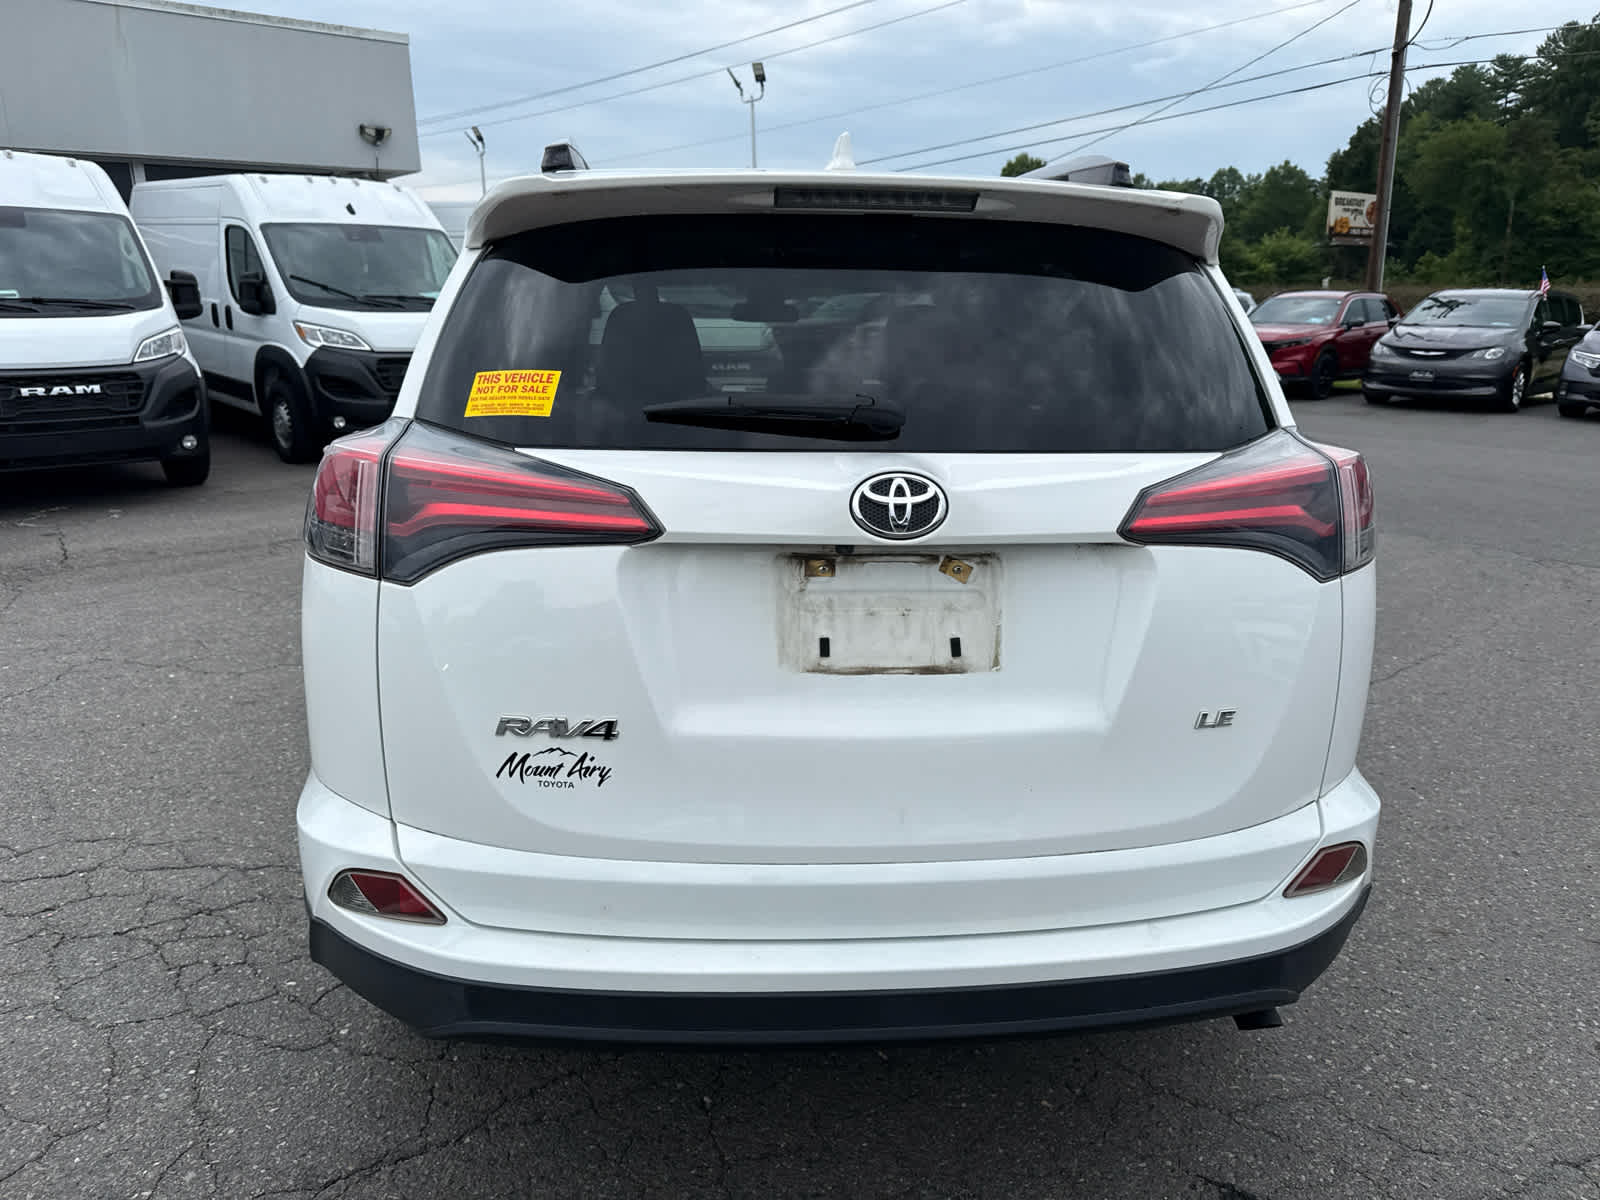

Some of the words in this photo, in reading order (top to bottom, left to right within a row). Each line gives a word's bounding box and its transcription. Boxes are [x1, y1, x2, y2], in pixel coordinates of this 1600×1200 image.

[477, 373, 502, 385] THIS
[504, 372, 555, 384] VEHICLE
[20, 384, 101, 397] RAM
[476, 385, 496, 394] NOT
[497, 385, 518, 394] FOR
[520, 384, 550, 394] SALE
[1194, 709, 1237, 729] LE
[494, 714, 619, 741] RAV4
[495, 751, 565, 785] Mount
[566, 751, 613, 788] Airy
[537, 780, 575, 789] TOYOTA
